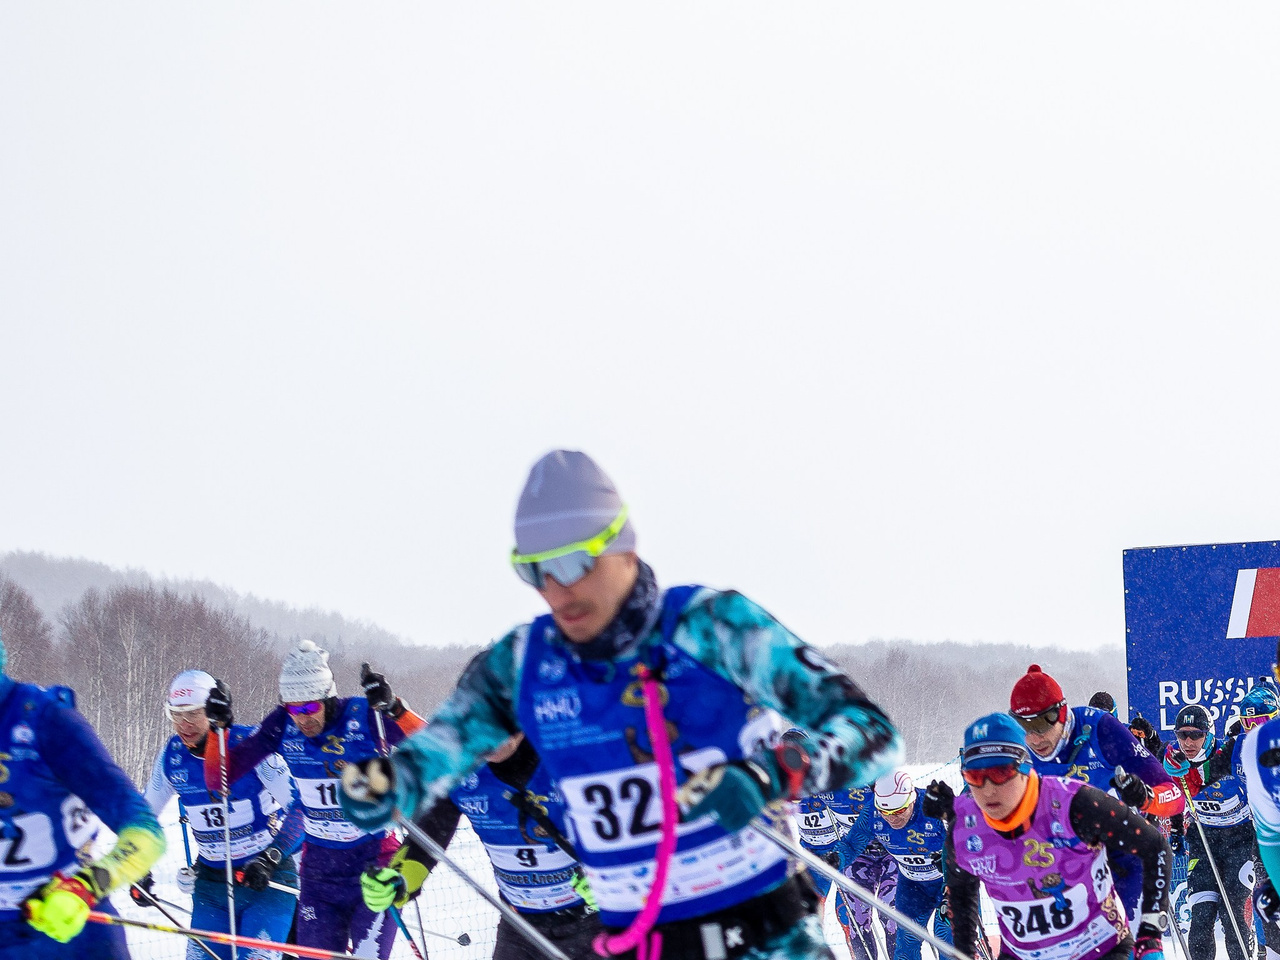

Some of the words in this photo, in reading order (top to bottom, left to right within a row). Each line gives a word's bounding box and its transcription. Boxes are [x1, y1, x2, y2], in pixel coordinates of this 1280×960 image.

[1158, 676, 1277, 705] RUSSI
[201, 807, 224, 828] 13
[804, 815, 822, 828] 42
[907, 829, 925, 845] 25
[1023, 838, 1055, 868] 25
[1002, 897, 1074, 938] 348
